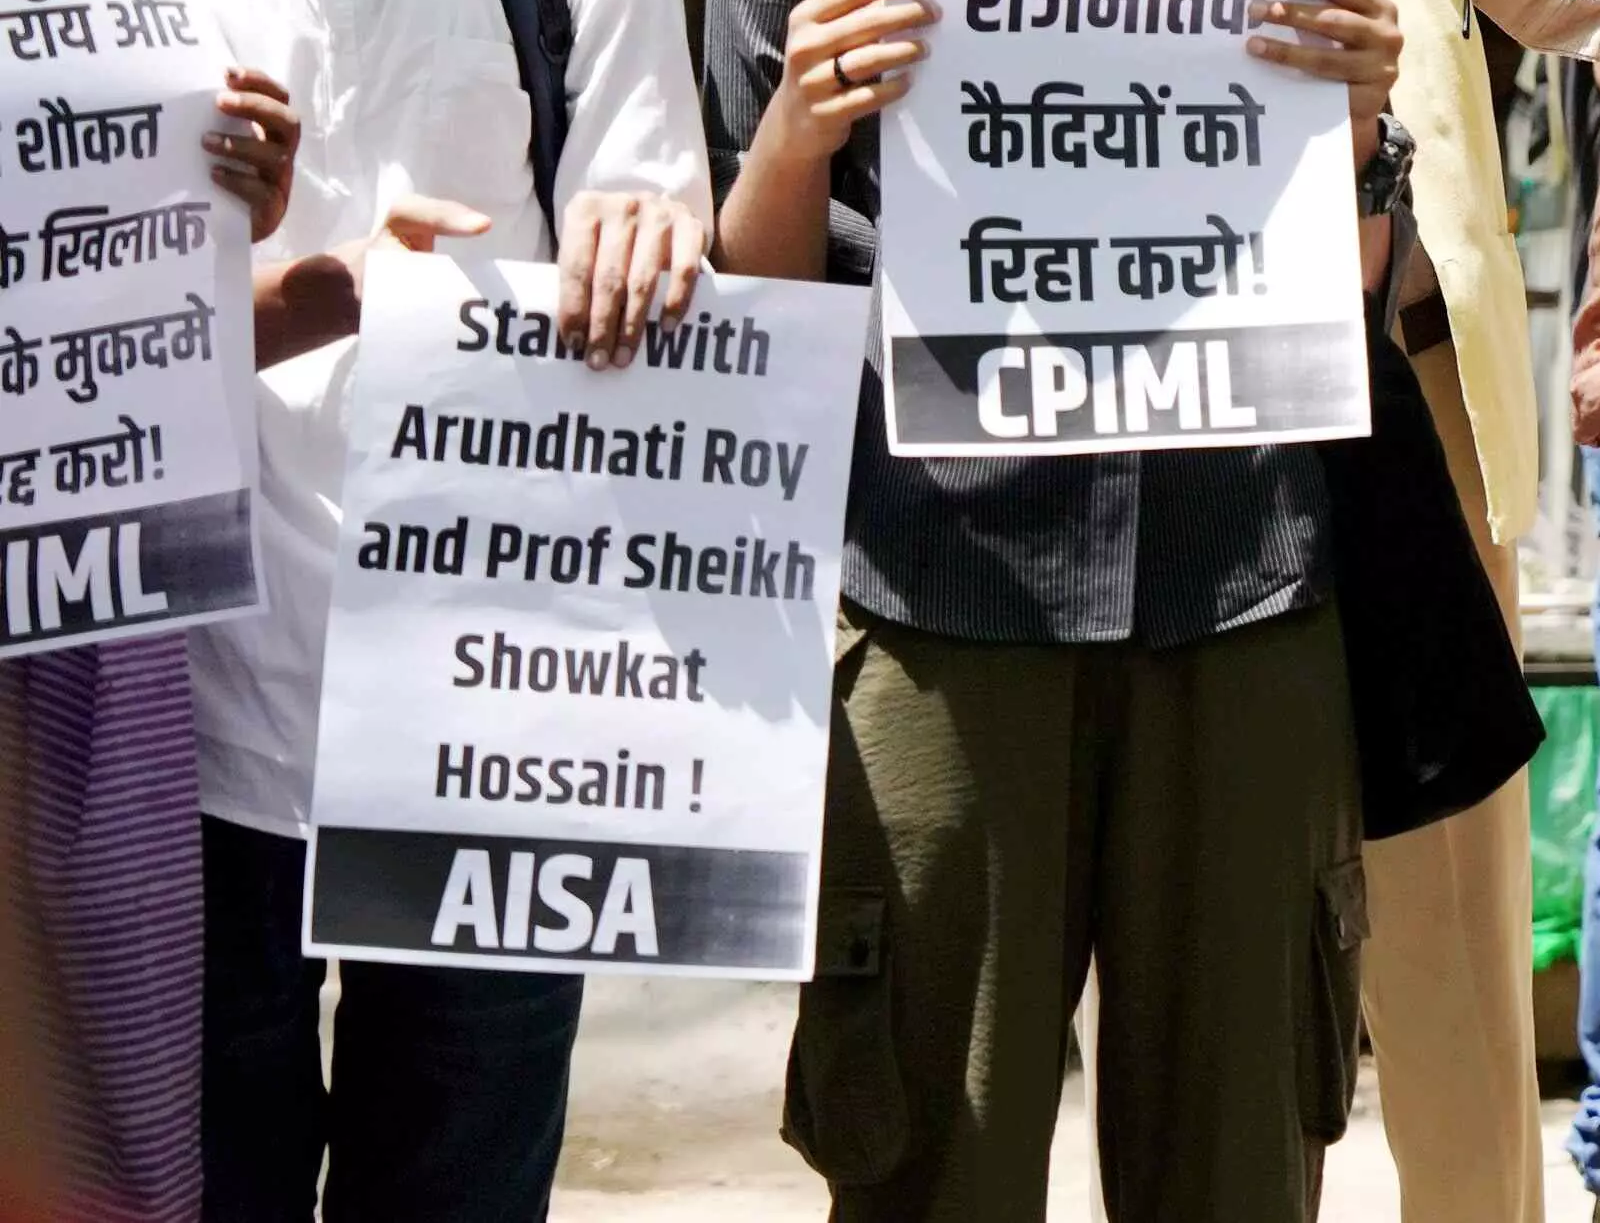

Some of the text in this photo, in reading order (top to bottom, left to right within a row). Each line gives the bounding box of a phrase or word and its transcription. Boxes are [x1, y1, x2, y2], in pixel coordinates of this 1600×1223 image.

[16, 96, 163, 172] शौकत
[961, 80, 1265, 168] कैदियों को
[39, 202, 211, 282] खिलाफ
[961, 214, 1269, 303] रिहा करो!
[0, 292, 215, 403] के मुकदमे
[456, 298, 770, 376] Sta with
[976, 340, 1257, 438] CPIML
[0, 414, 164, 506] द्द करो!
[390, 404, 809, 501] Arundhati Roy
[6, 522, 169, 635] IML
[358, 516, 816, 600] and Prof Sheikh
[453, 631, 707, 702] Showkat
[435, 744, 666, 811] Hossain
[430, 847, 659, 957] AISA
